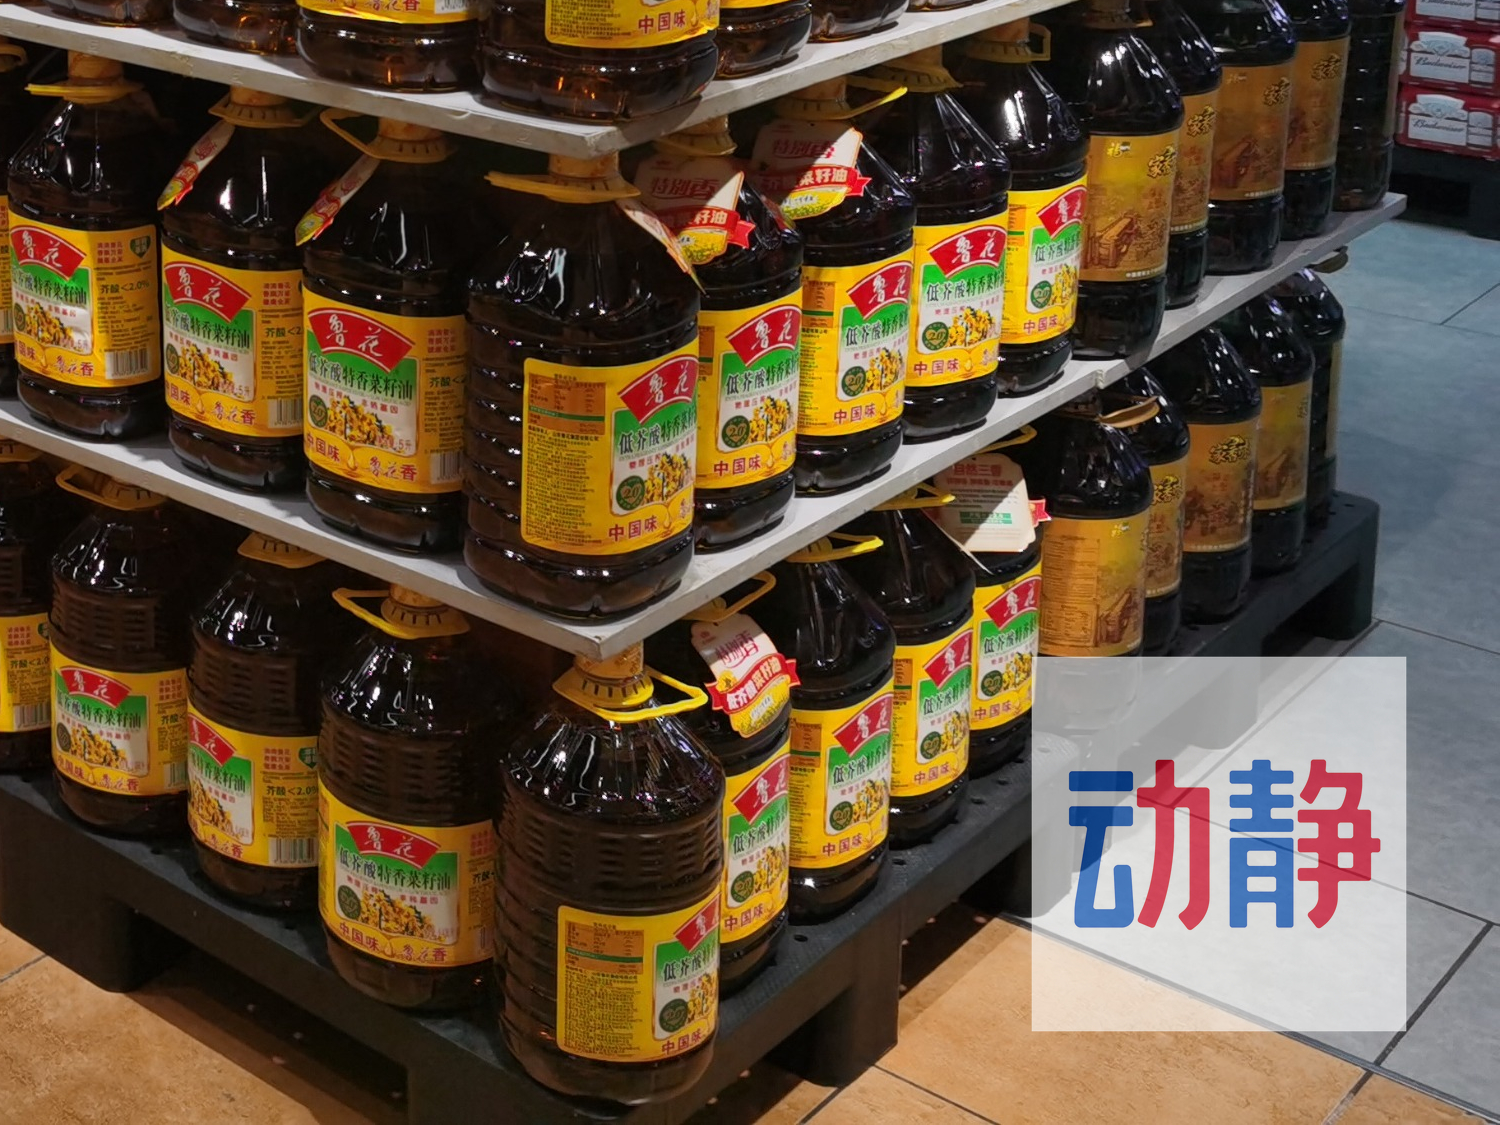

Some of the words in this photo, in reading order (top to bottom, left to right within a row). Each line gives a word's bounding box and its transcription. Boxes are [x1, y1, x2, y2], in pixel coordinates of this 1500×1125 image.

[638, 10, 687, 34] 中国味
[1048, 192, 1084, 226] 鲁花
[21, 231, 63, 269] 鲁花
[952, 229, 998, 264] 鲁花
[100, 280, 150, 294] 芥酸<2.0%
[176, 267, 226, 310] 鲁花
[863, 268, 910, 308] 鲁花
[326, 314, 384, 359] 鲁花
[752, 311, 798, 351] 鲁花
[929, 332, 944, 343] 2.0
[1023, 317, 1058, 334] 中国味
[308, 350, 414, 401] 低芥酸特香菜籽油
[913, 357, 959, 376] 中国味
[648, 363, 693, 406] 鲁花
[833, 403, 877, 425] 中国味
[728, 426, 745, 438] 2.0
[306, 434, 341, 464] 中国味
[368, 455, 418, 482] 鲁花香
[713, 455, 762, 477] 中国味
[622, 485, 639, 499] 2.0
[608, 516, 658, 543] 中国味
[1002, 578, 1038, 615] 鲁花
[938, 633, 972, 674] 鲁花
[73, 670, 110, 699] 鲁花
[855, 706, 890, 740] 鲁花
[974, 703, 1011, 720] 中国味
[755, 762, 789, 805] 鲁花
[913, 763, 950, 785] 中国味
[366, 825, 417, 860] 鲁花
[821, 831, 863, 857] 中国味
[338, 847, 452, 891] 低芥酸特香菜籽油
[723, 902, 764, 933] 中国味
[339, 921, 380, 953] 中国味
[401, 944, 448, 964] 鲁花香
[660, 1029, 702, 1056] 中国味
